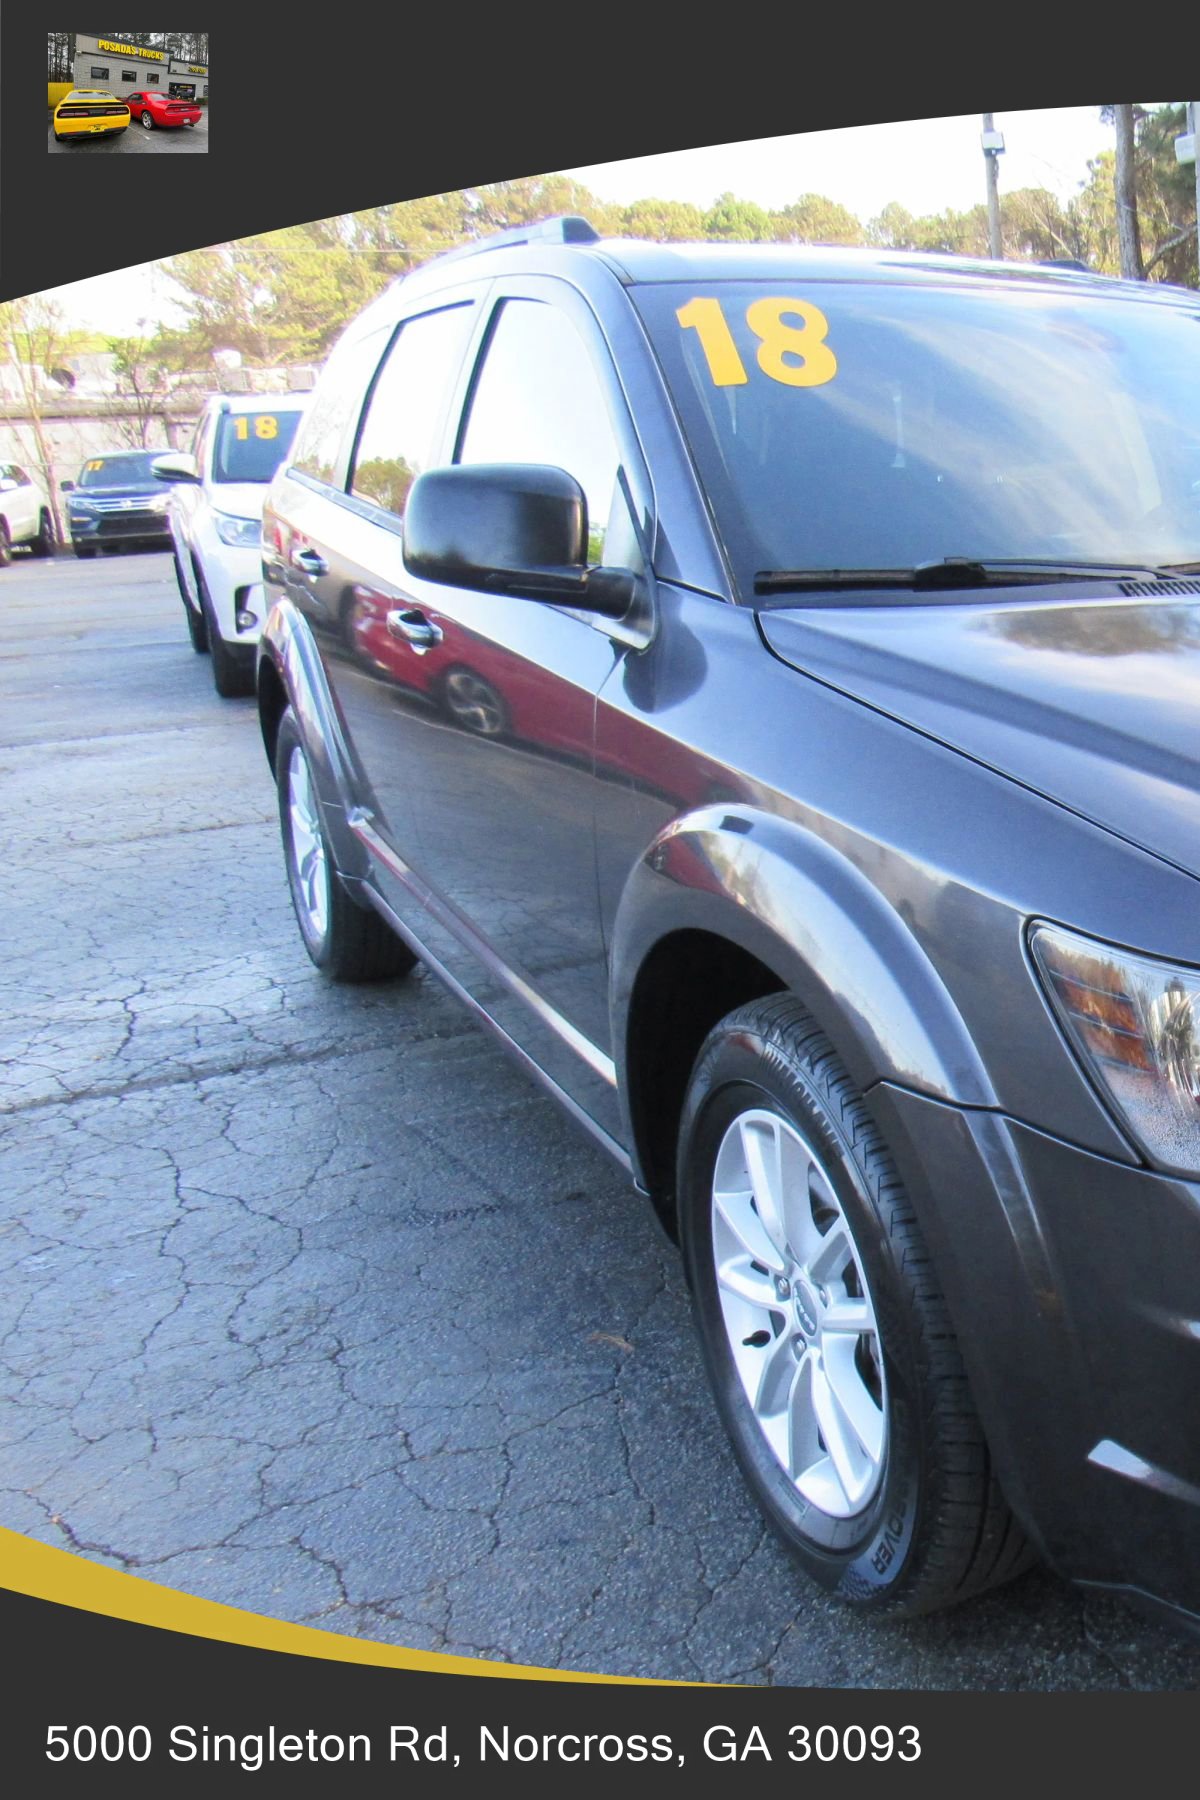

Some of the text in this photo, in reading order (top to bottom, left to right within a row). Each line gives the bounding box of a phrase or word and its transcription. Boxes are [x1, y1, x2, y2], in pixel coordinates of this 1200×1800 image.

[675, 296, 838, 387] 18
[233, 415, 278, 440] 18
[86, 460, 104, 471] 17
